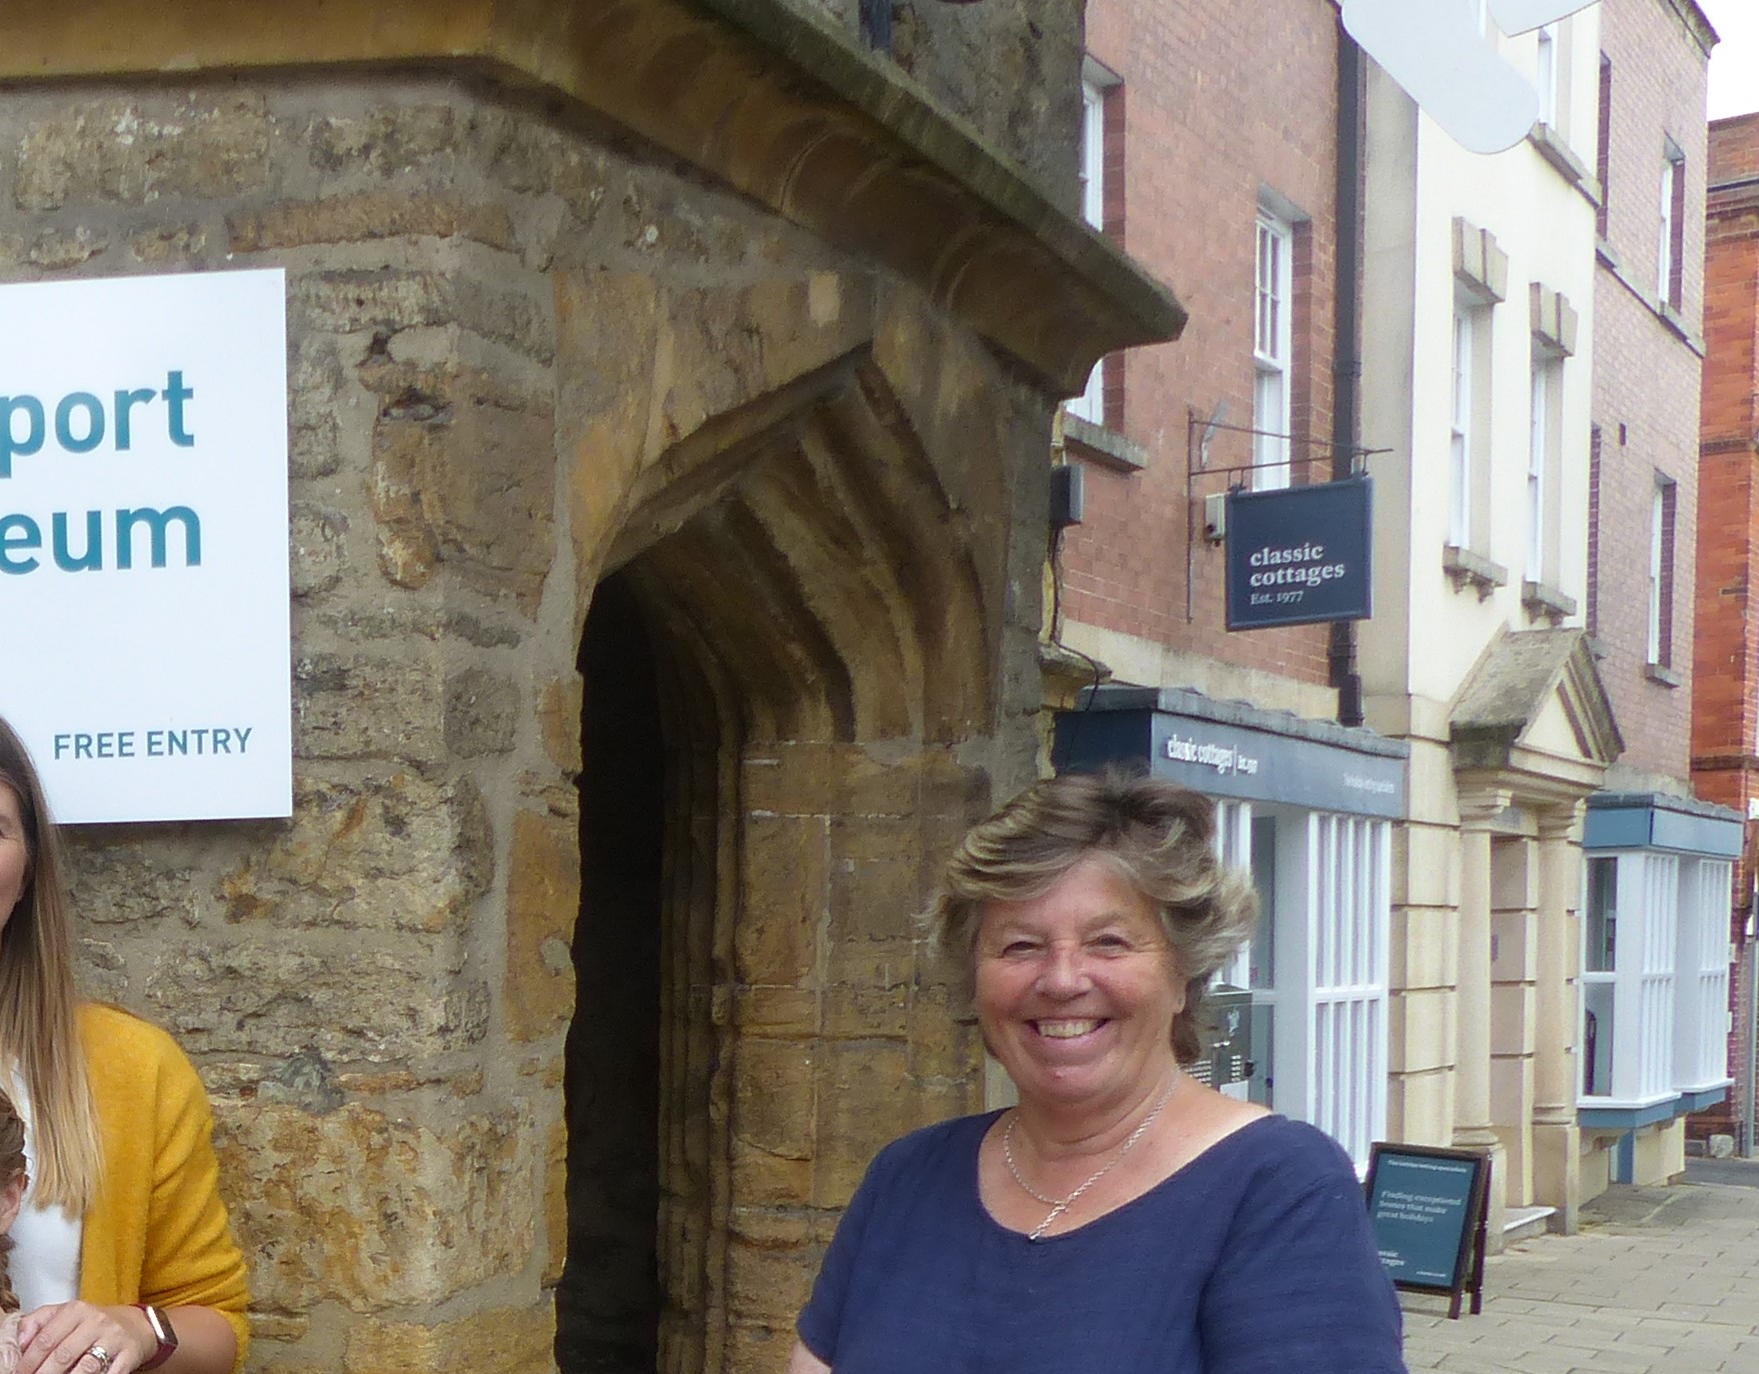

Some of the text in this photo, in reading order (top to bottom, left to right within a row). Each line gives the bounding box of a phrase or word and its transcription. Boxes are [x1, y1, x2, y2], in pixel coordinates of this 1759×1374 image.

[1250, 542, 1324, 567] classic
[1250, 563, 1345, 587] cottages
[1250, 590, 1304, 605] Est. 1977
[53, 727, 253, 760] FREE ENTRY
[1167, 733, 1197, 762] classic
[1197, 744, 1233, 774] cottages
